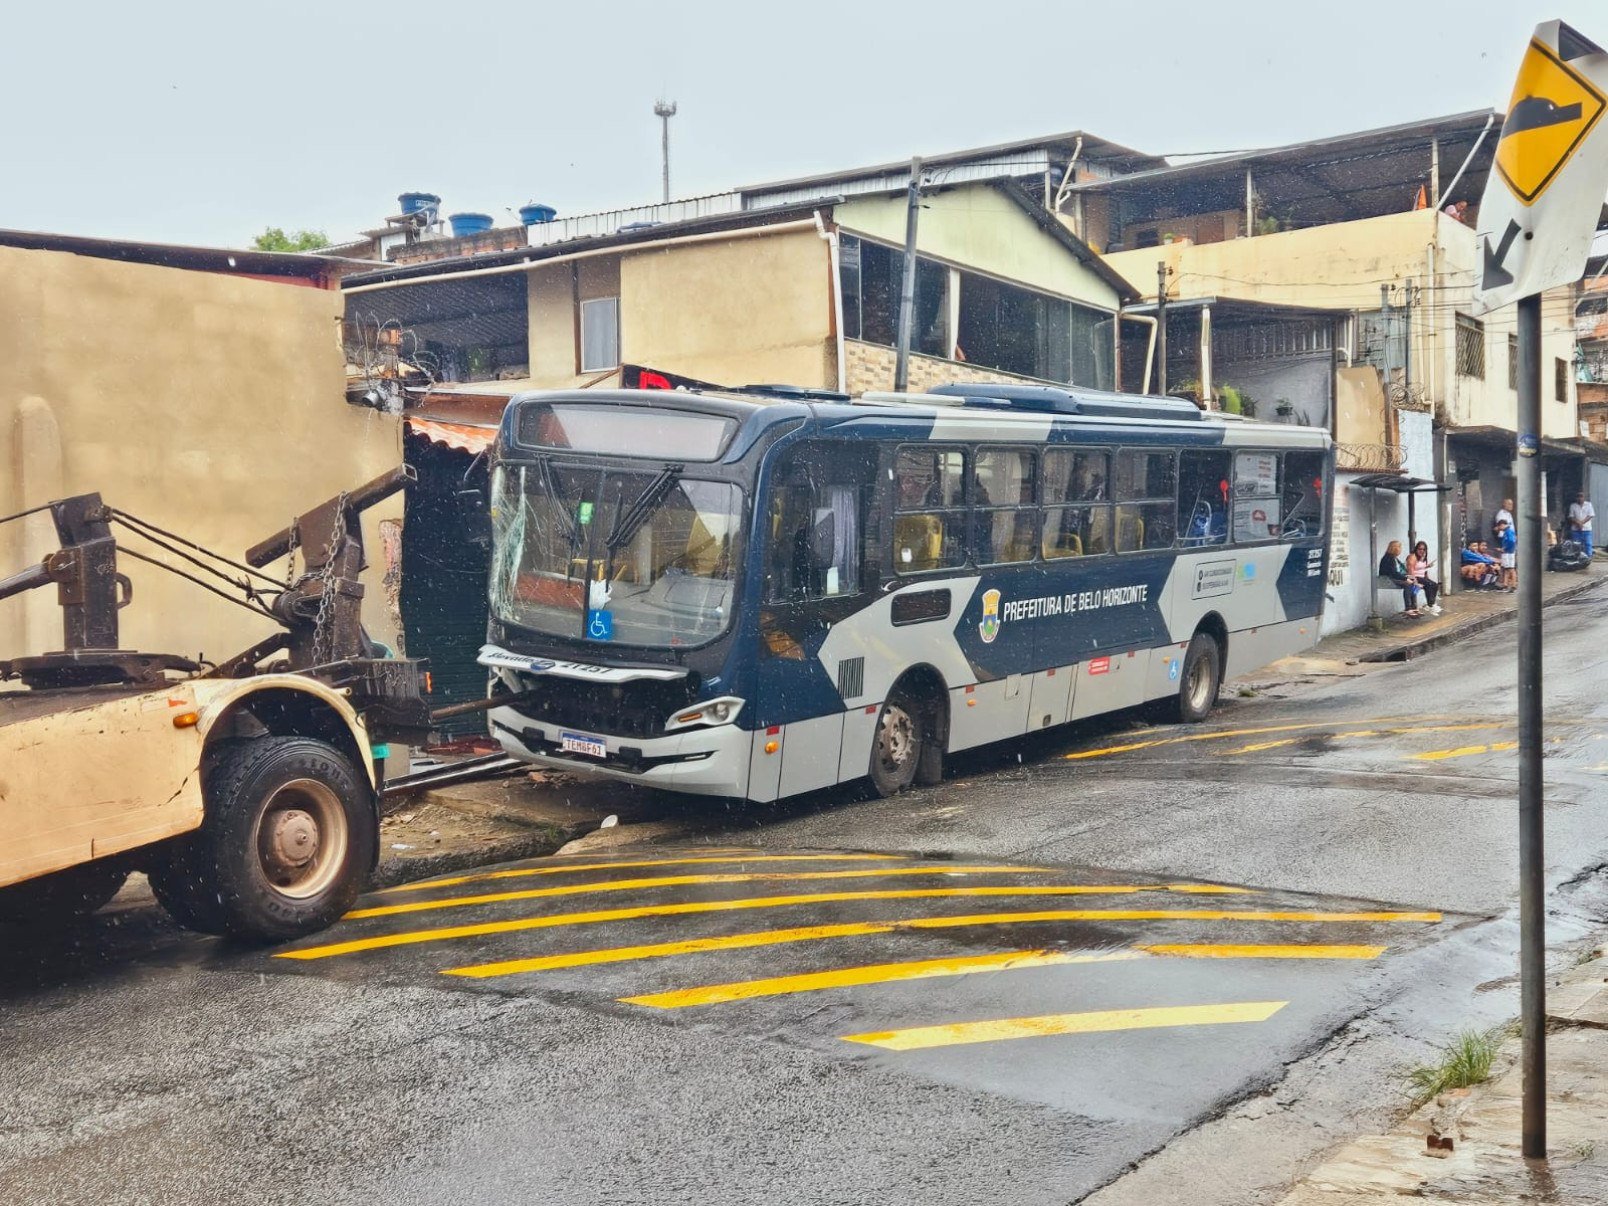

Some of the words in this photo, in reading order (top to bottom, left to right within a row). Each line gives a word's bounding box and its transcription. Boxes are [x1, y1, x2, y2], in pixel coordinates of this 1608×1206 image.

[1004, 596, 1062, 622] PREFEITURA
[1064, 594, 1077, 613] DE
[1078, 590, 1101, 611] BELO
[1102, 585, 1148, 607] HORIZONTE
